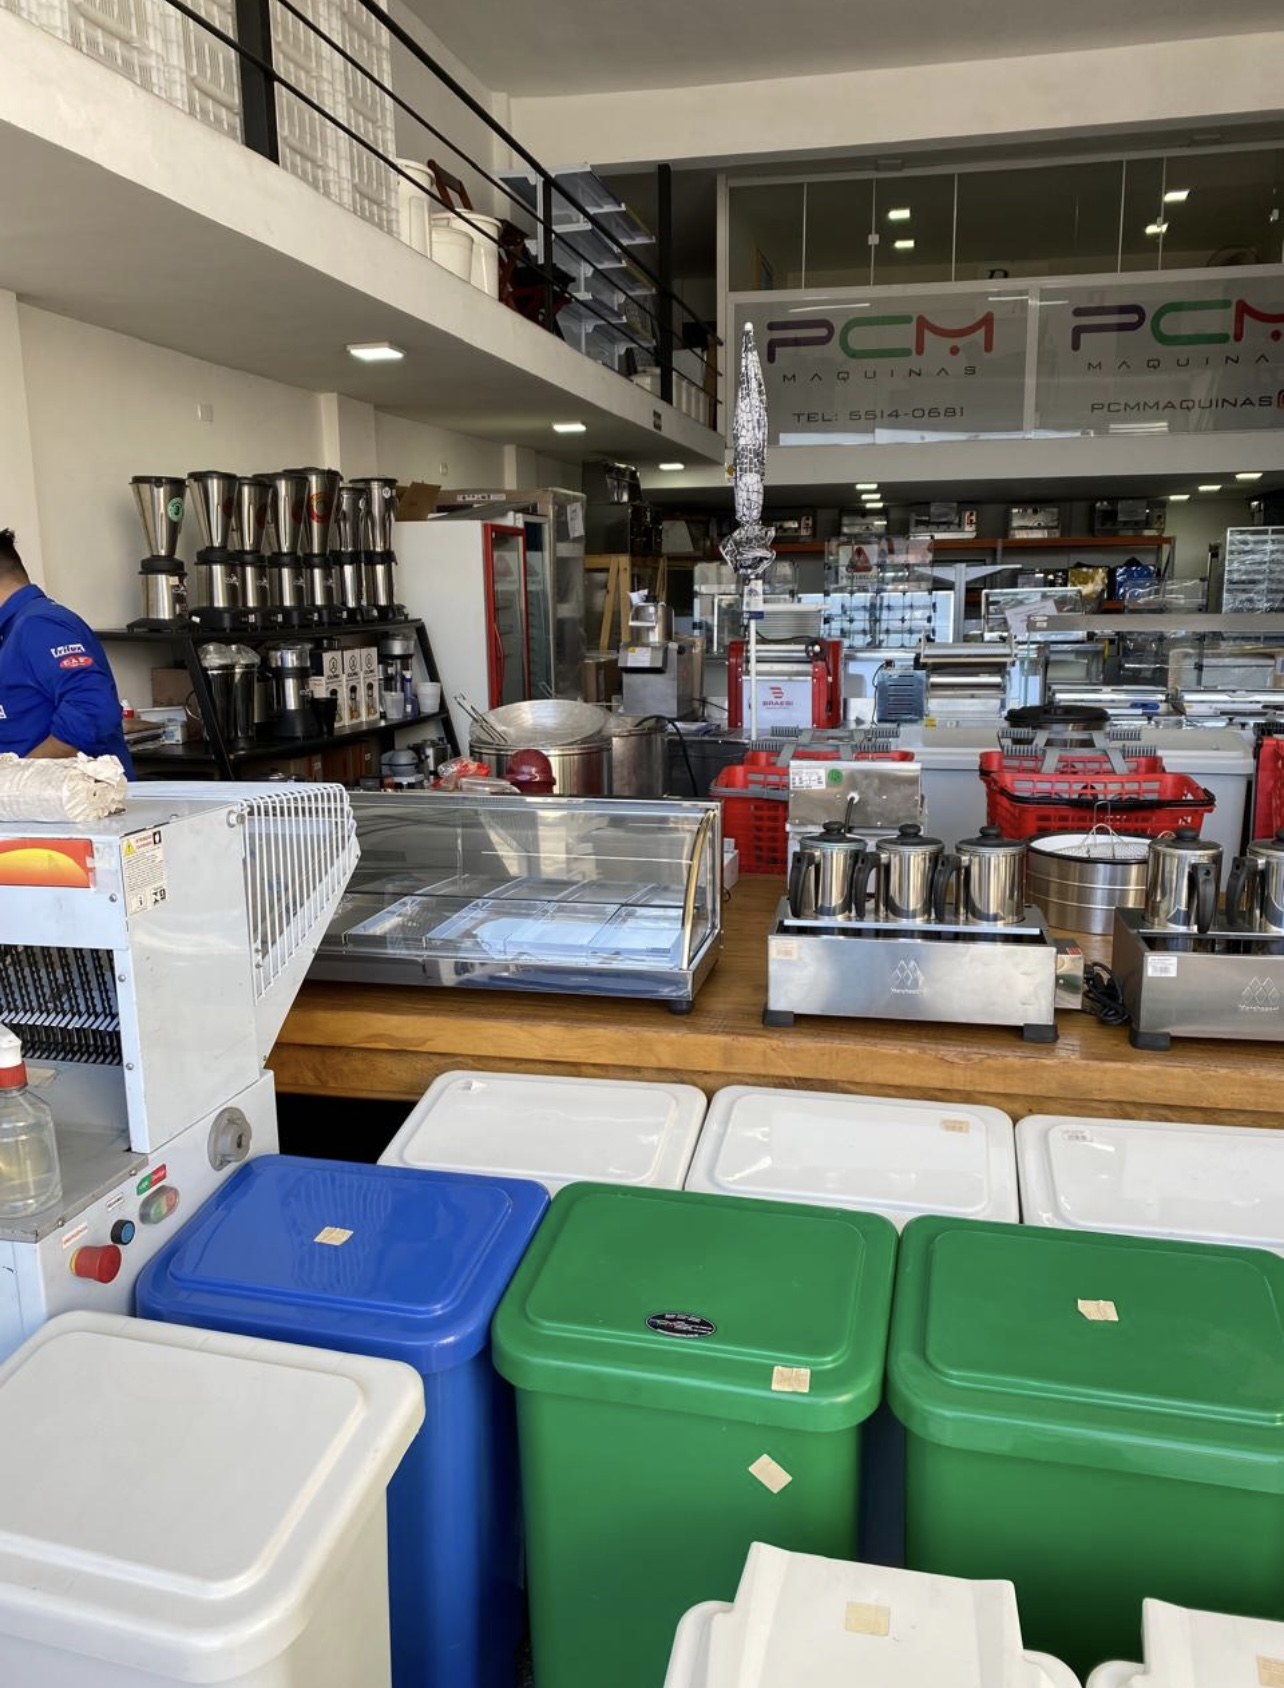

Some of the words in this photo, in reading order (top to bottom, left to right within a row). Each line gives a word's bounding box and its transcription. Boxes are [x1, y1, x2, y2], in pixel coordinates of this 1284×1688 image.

[767, 311, 995, 364] PCM
[782, 366, 977, 383] MAQUINAS
[1090, 395, 1274, 413] PCMMAQUINAS
[792, 411, 839, 423] TEL:
[849, 406, 964, 421] 5514-0681
